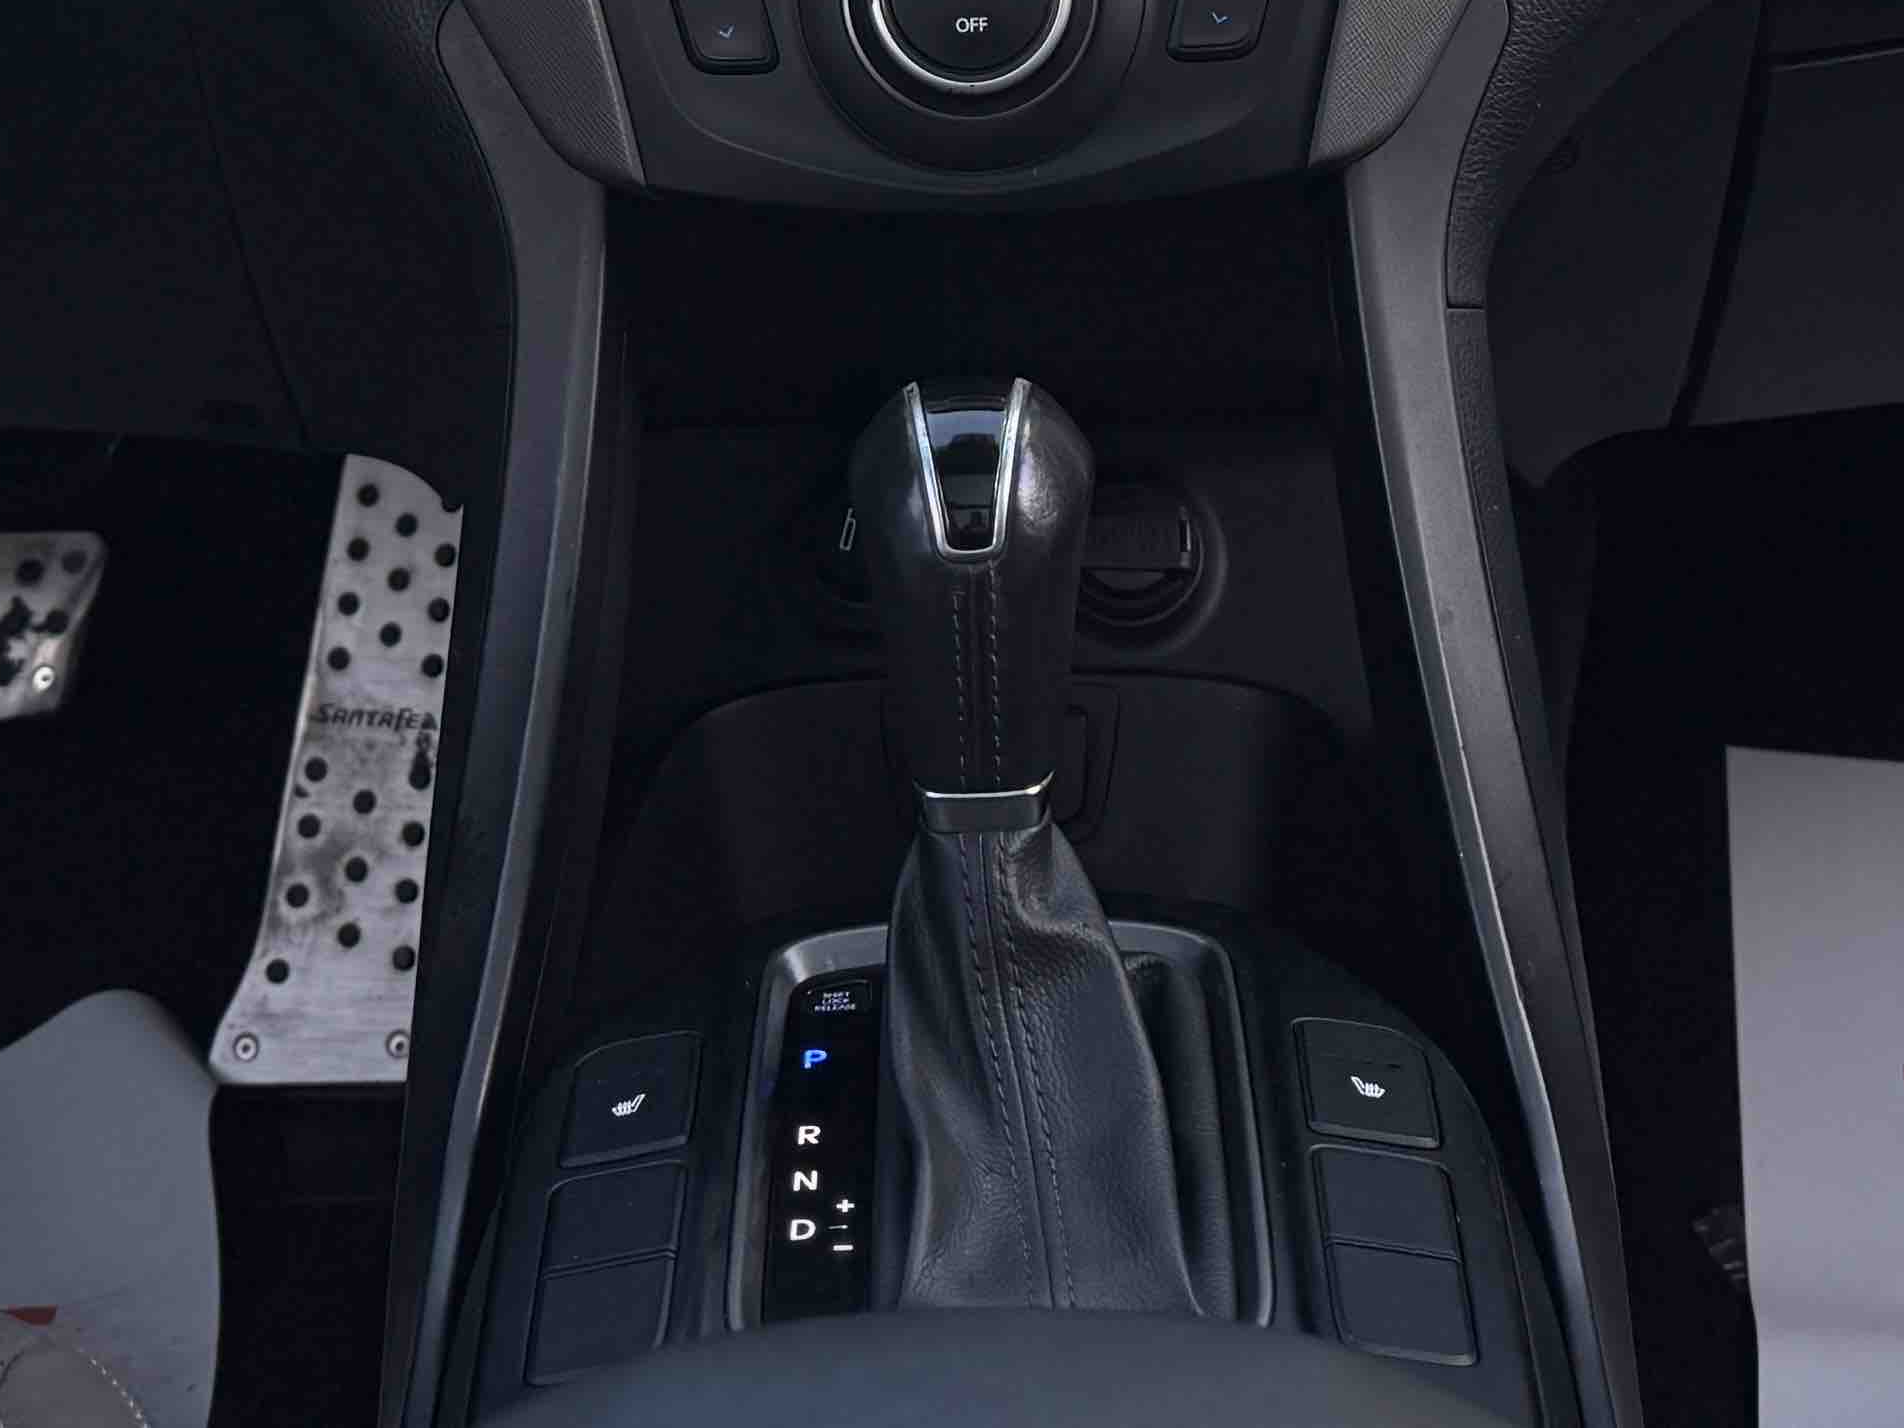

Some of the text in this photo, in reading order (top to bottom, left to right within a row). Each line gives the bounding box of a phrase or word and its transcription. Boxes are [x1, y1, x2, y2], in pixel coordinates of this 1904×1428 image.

[955, 16, 989, 35] OFF
[804, 1049, 828, 1070] P
[797, 1125, 822, 1146] R
[793, 1169, 819, 1192] N
[788, 1218, 817, 1242] D
